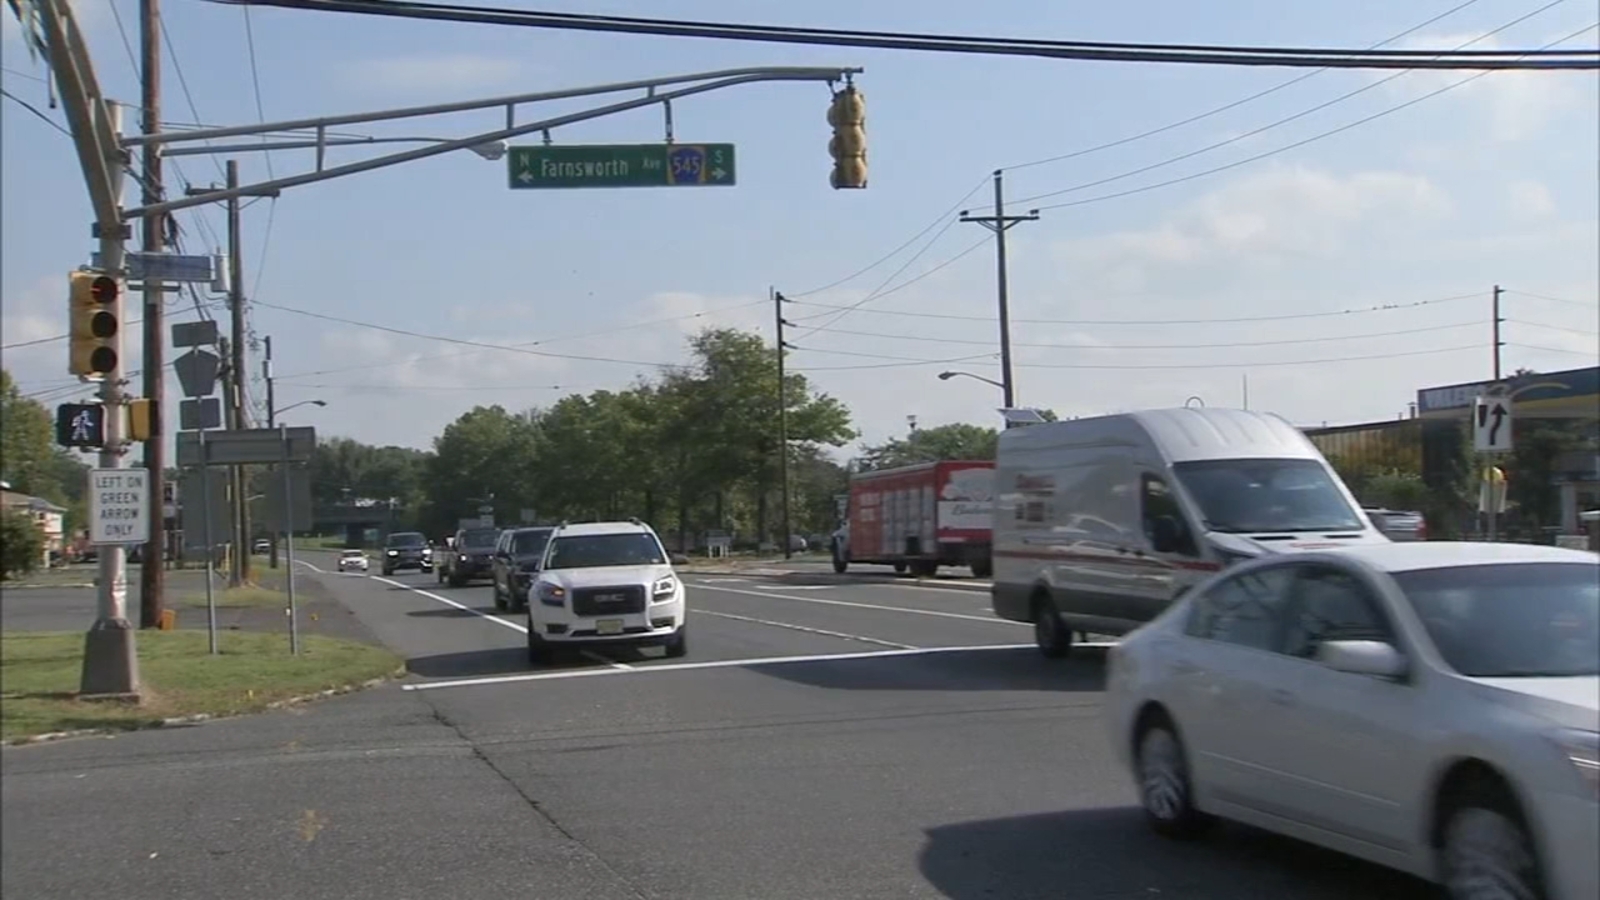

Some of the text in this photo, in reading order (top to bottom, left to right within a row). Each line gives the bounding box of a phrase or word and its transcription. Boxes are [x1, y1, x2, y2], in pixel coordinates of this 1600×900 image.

[520, 153, 530, 167] N
[715, 150, 723, 163] S
[541, 156, 661, 177] Farnsworth Ave
[673, 156, 700, 174] 545
[95, 476, 142, 488] LEFT ON
[101, 492, 139, 504] GREEN
[101, 508, 139, 520] ARROW
[105, 524, 133, 536] ONLY
